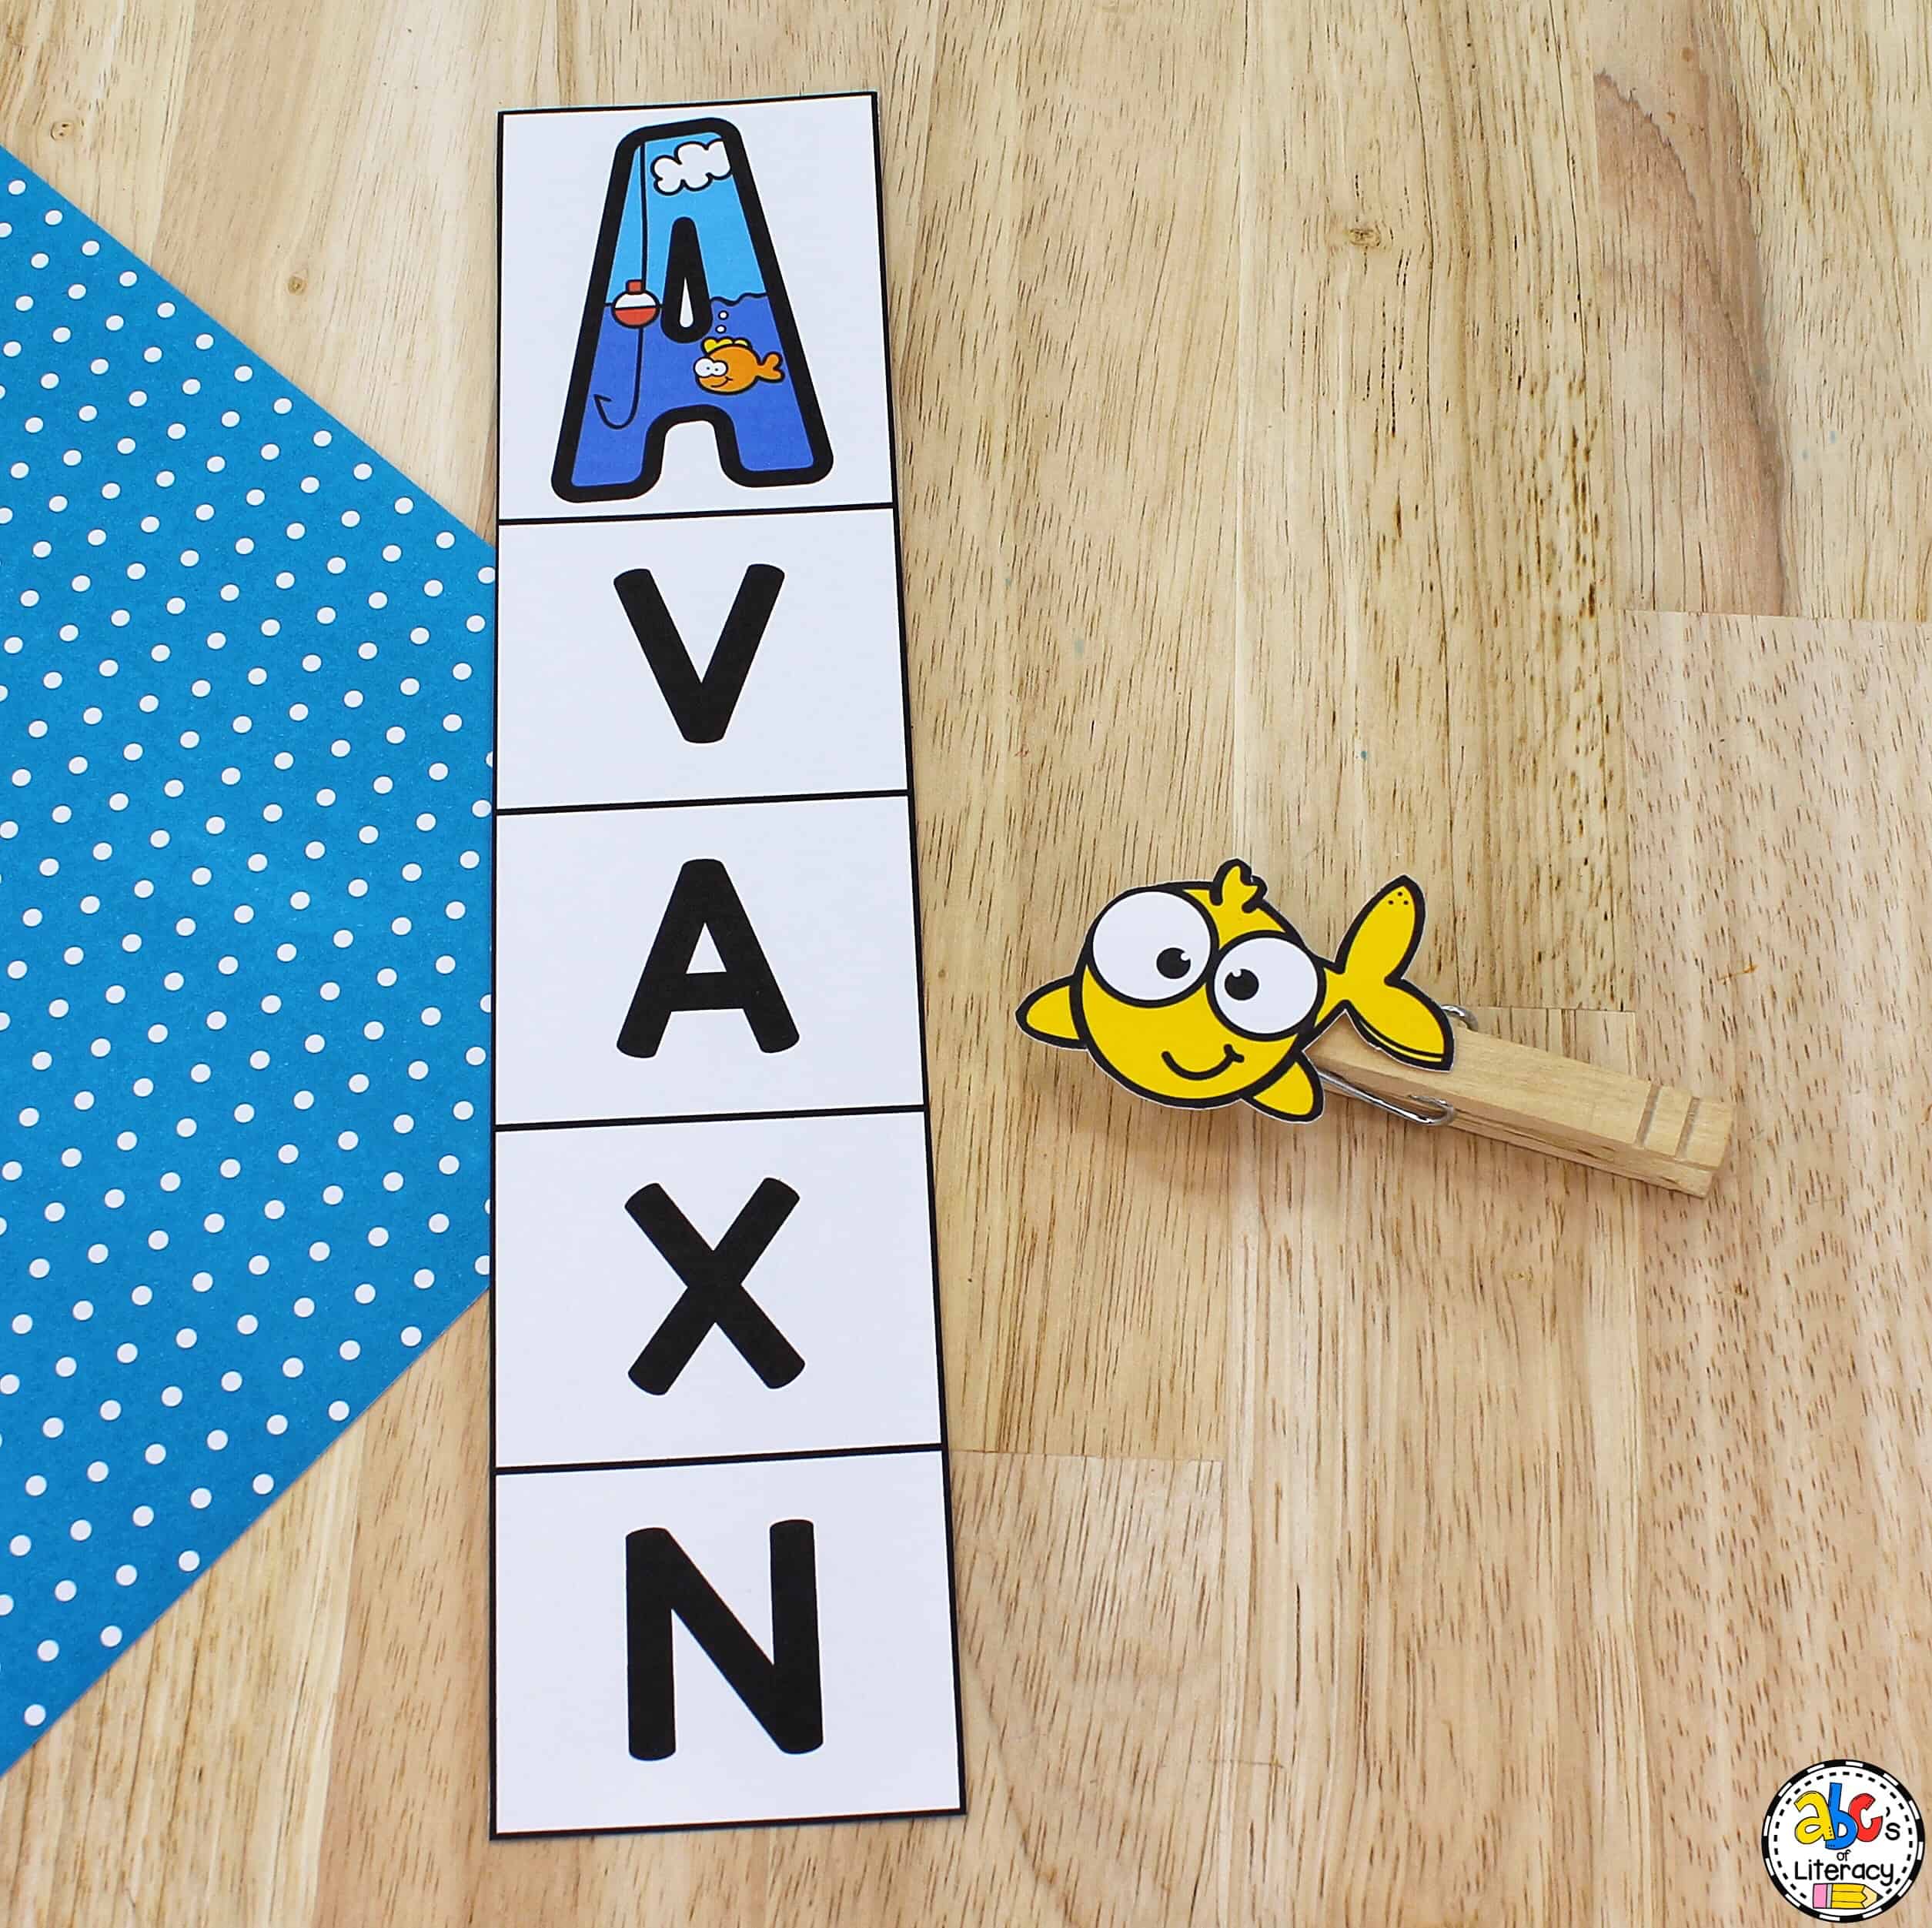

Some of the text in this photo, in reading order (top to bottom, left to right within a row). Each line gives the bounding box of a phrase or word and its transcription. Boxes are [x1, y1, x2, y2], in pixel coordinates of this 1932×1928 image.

[550, 117, 834, 503] A
[613, 563, 785, 744] V
[616, 858, 800, 1059] A
[624, 1178, 805, 1396] X
[625, 1519, 824, 1761] N
